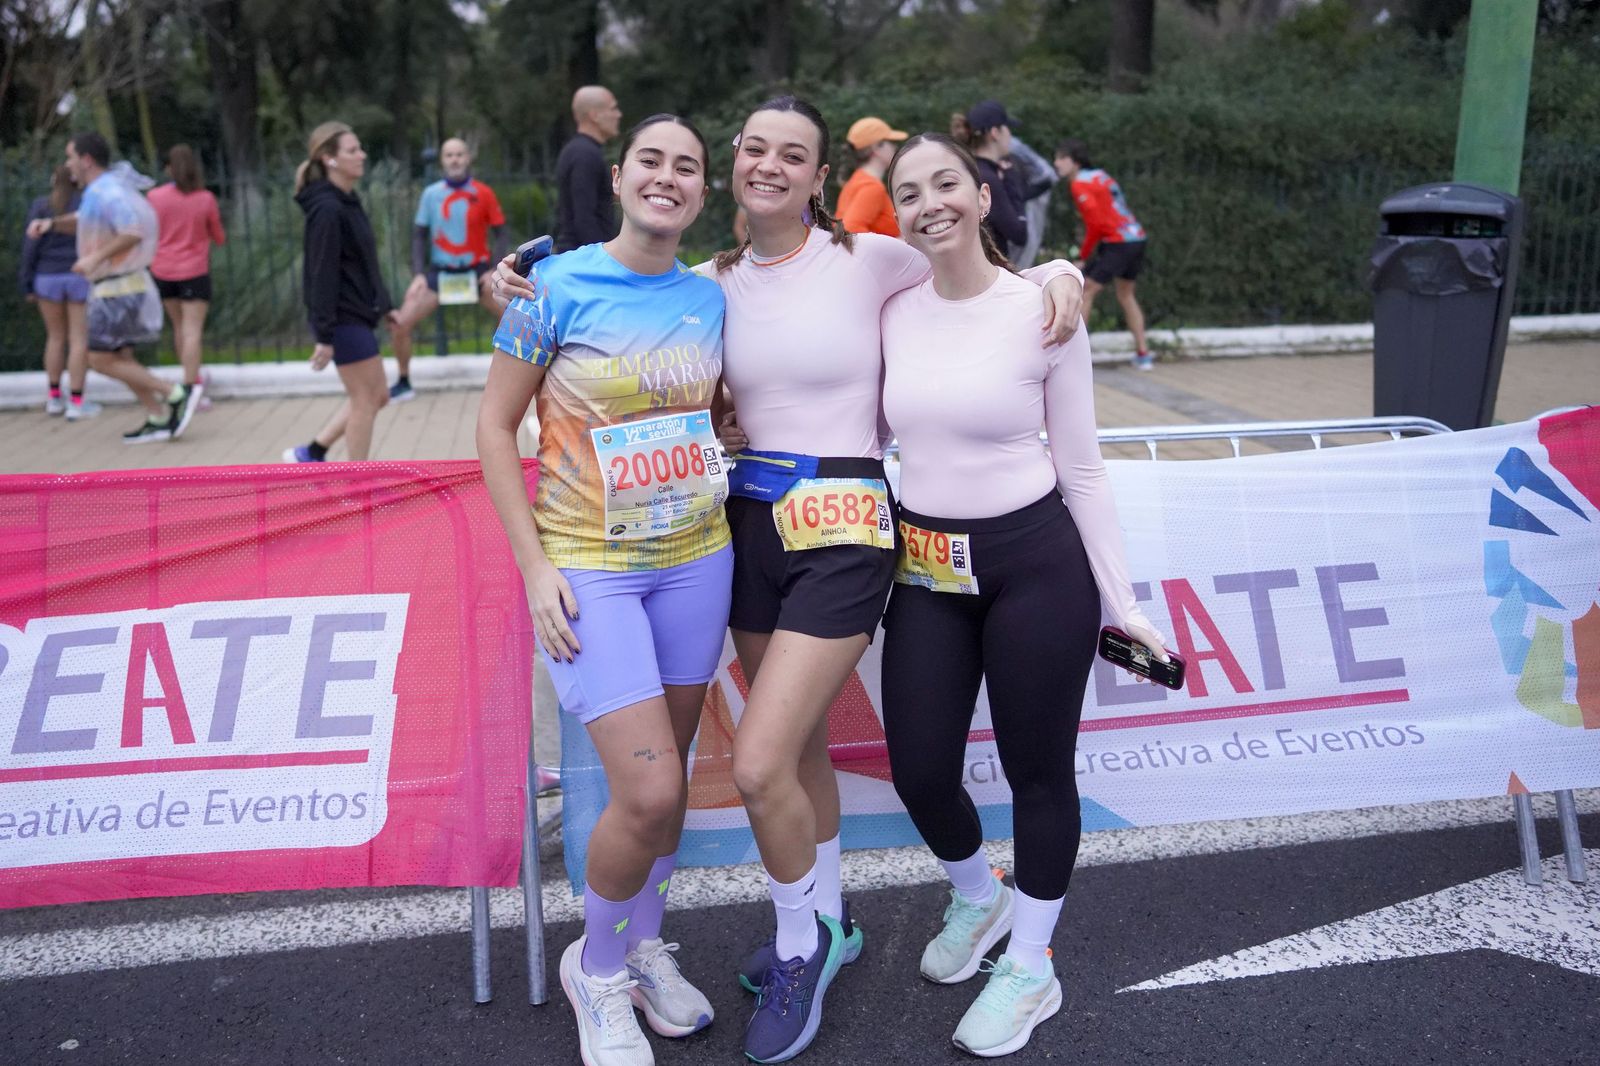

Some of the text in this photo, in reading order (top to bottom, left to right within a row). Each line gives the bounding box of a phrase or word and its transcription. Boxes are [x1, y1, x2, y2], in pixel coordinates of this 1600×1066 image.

[618, 342, 700, 377] MEDIO
[636, 418, 681, 433] maratón
[648, 426, 682, 440] sevilla
[611, 442, 706, 491] 20008
[635, 499, 653, 508] Nuria
[653, 497, 669, 506] Calle
[657, 485, 675, 494] Calle
[784, 493, 878, 531] 16582
[821, 528, 848, 537] AINHOA
[0, 612, 387, 755] EATE
[1223, 731, 1270, 761] de
[1278, 719, 1426, 756] Eventos
[0, 789, 367, 840] eativa de Eventos
